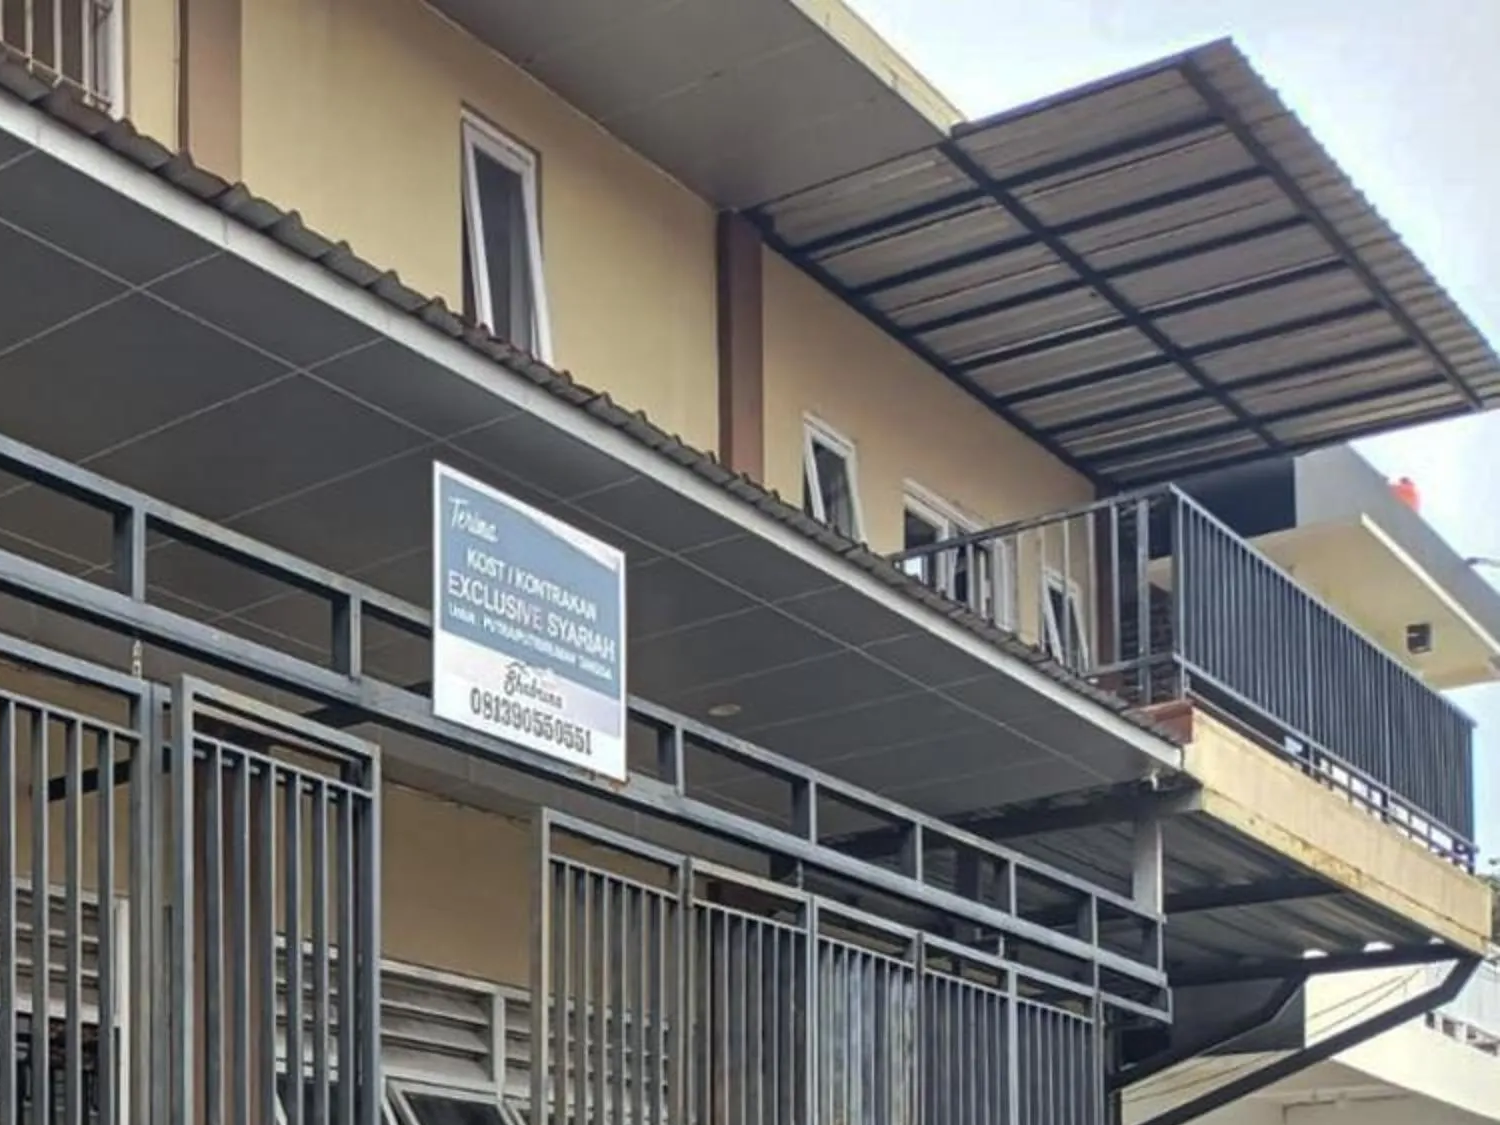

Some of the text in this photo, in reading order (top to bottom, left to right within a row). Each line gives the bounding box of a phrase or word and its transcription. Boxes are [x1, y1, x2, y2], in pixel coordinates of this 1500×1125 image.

[448, 569, 543, 630] EXCLUSIVE
[547, 611, 616, 662] SYARIAH
[467, 547, 506, 581] KOST
[515, 566, 597, 623] KONTRAKAN
